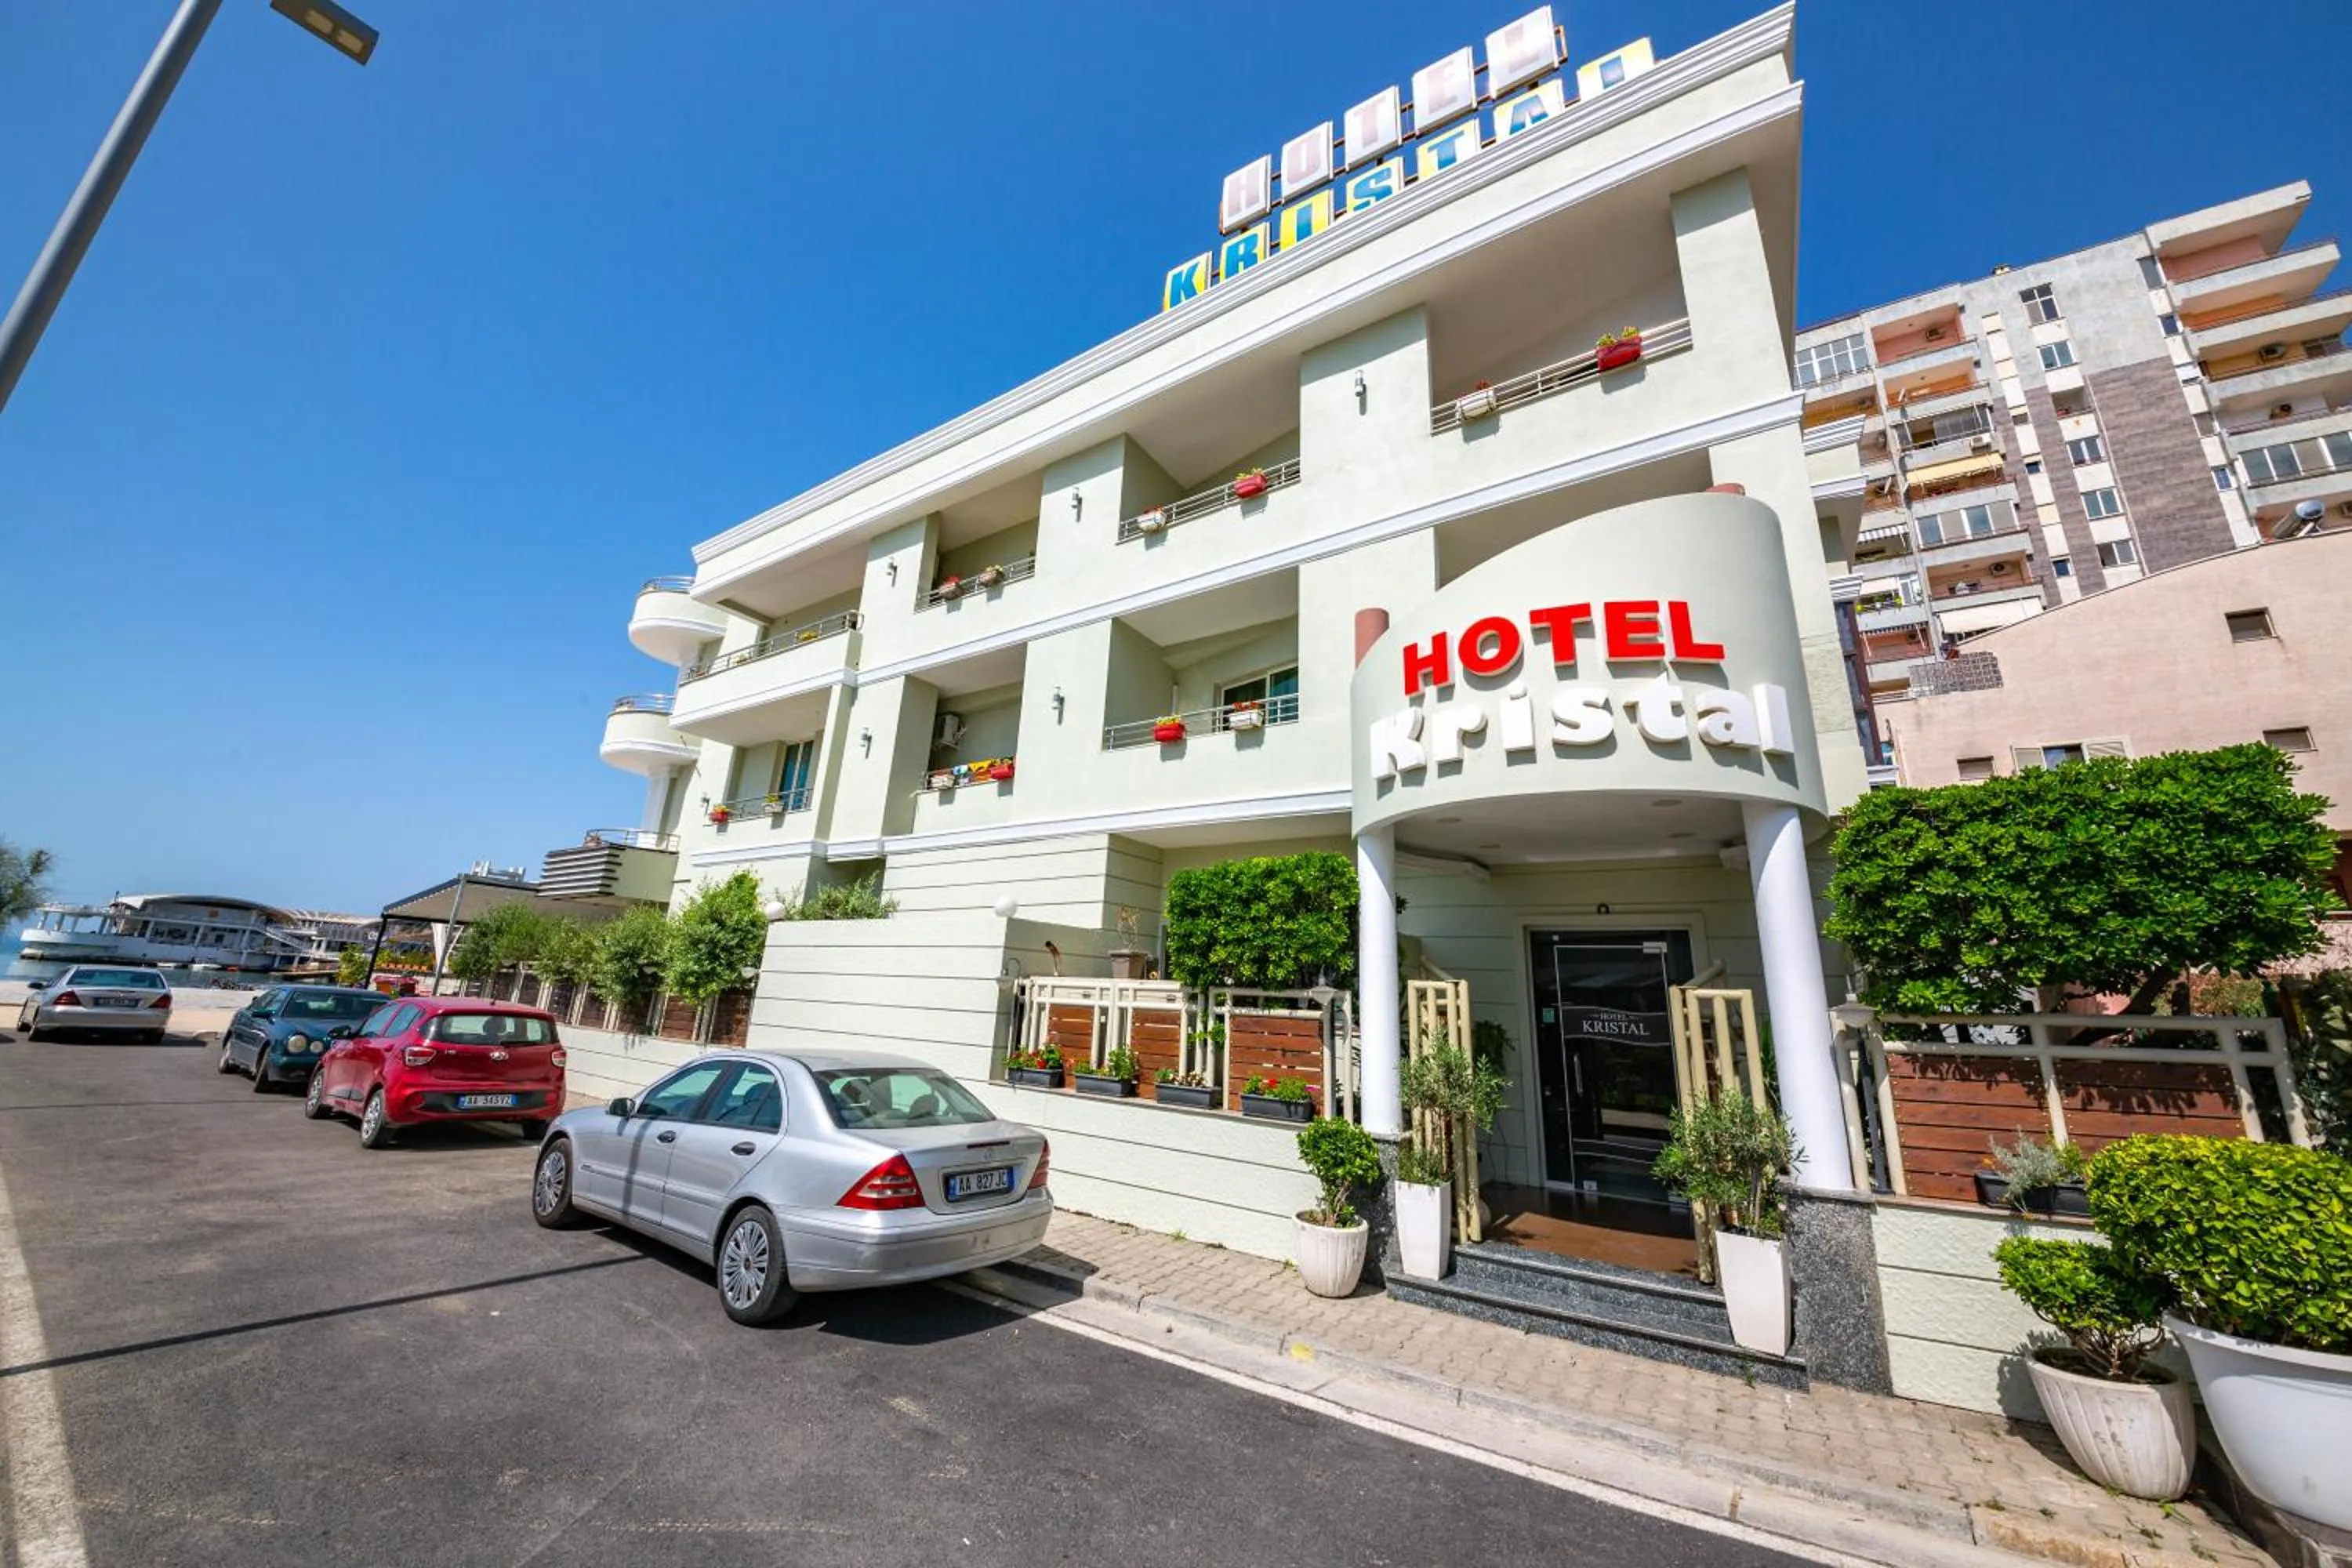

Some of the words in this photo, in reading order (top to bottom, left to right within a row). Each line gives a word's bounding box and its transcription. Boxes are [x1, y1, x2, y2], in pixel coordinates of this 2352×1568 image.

[1226, 22, 1541, 219] HOTEL
[1403, 600, 1726, 697] HOTEL
[1582, 1020, 1650, 1036] KRISTAL
[959, 1178, 971, 1192] AA
[976, 1173, 993, 1190] 827
